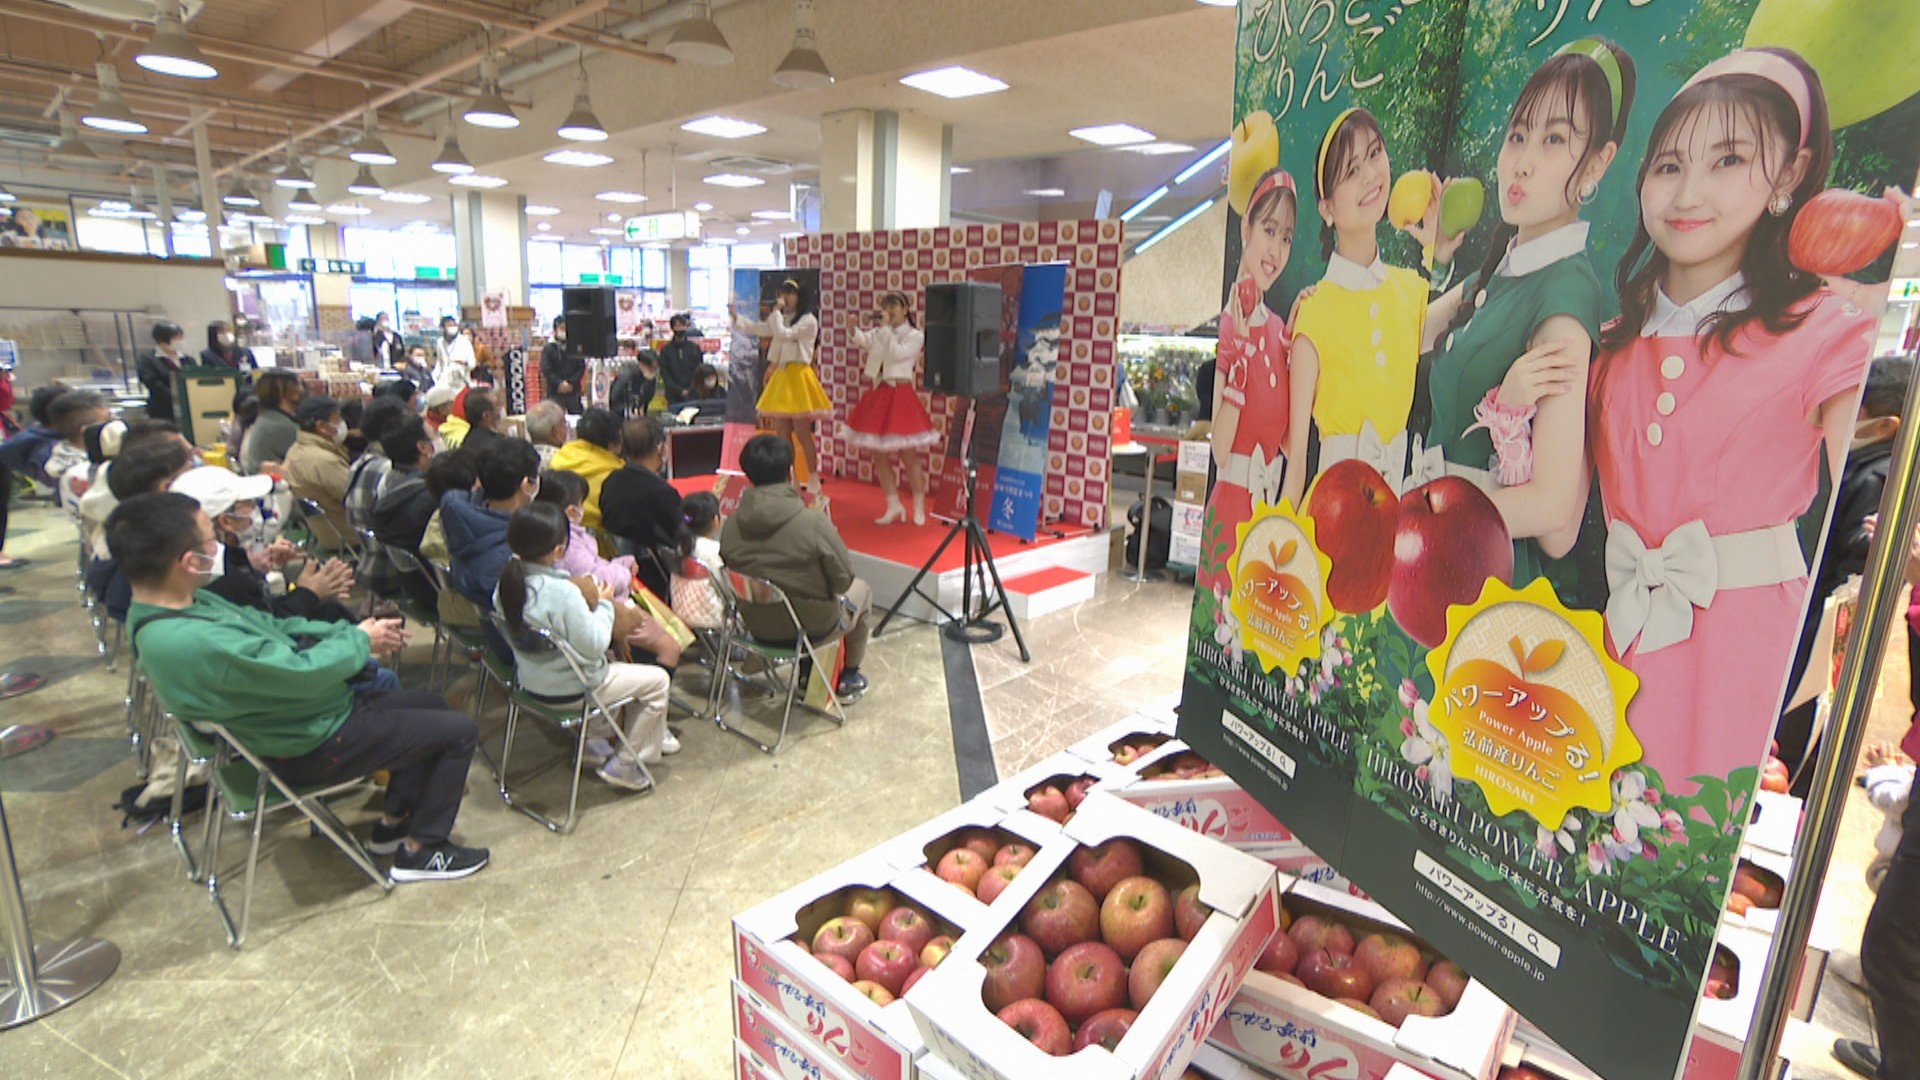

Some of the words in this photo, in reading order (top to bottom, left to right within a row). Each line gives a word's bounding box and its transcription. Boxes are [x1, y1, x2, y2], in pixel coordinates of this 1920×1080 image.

[1273, 7, 1403, 124] りんご
[1194, 638, 1249, 685] HIROSAKI
[1251, 673, 1300, 719] POWER
[1303, 708, 1350, 755] APPLE
[1479, 710, 1516, 737] Power
[1517, 730, 1554, 757] Apple
[1462, 727, 1563, 792] 弘前産りんご
[1474, 763, 1537, 805] HIROSAKI
[1366, 748, 1465, 826] HIROSAKI
[1469, 811, 1564, 888] POWER
[1574, 878, 1681, 957] APPLE
[1415, 880, 1546, 982] http://www.power-apple.jp
[806, 1010, 874, 1067] りんご
